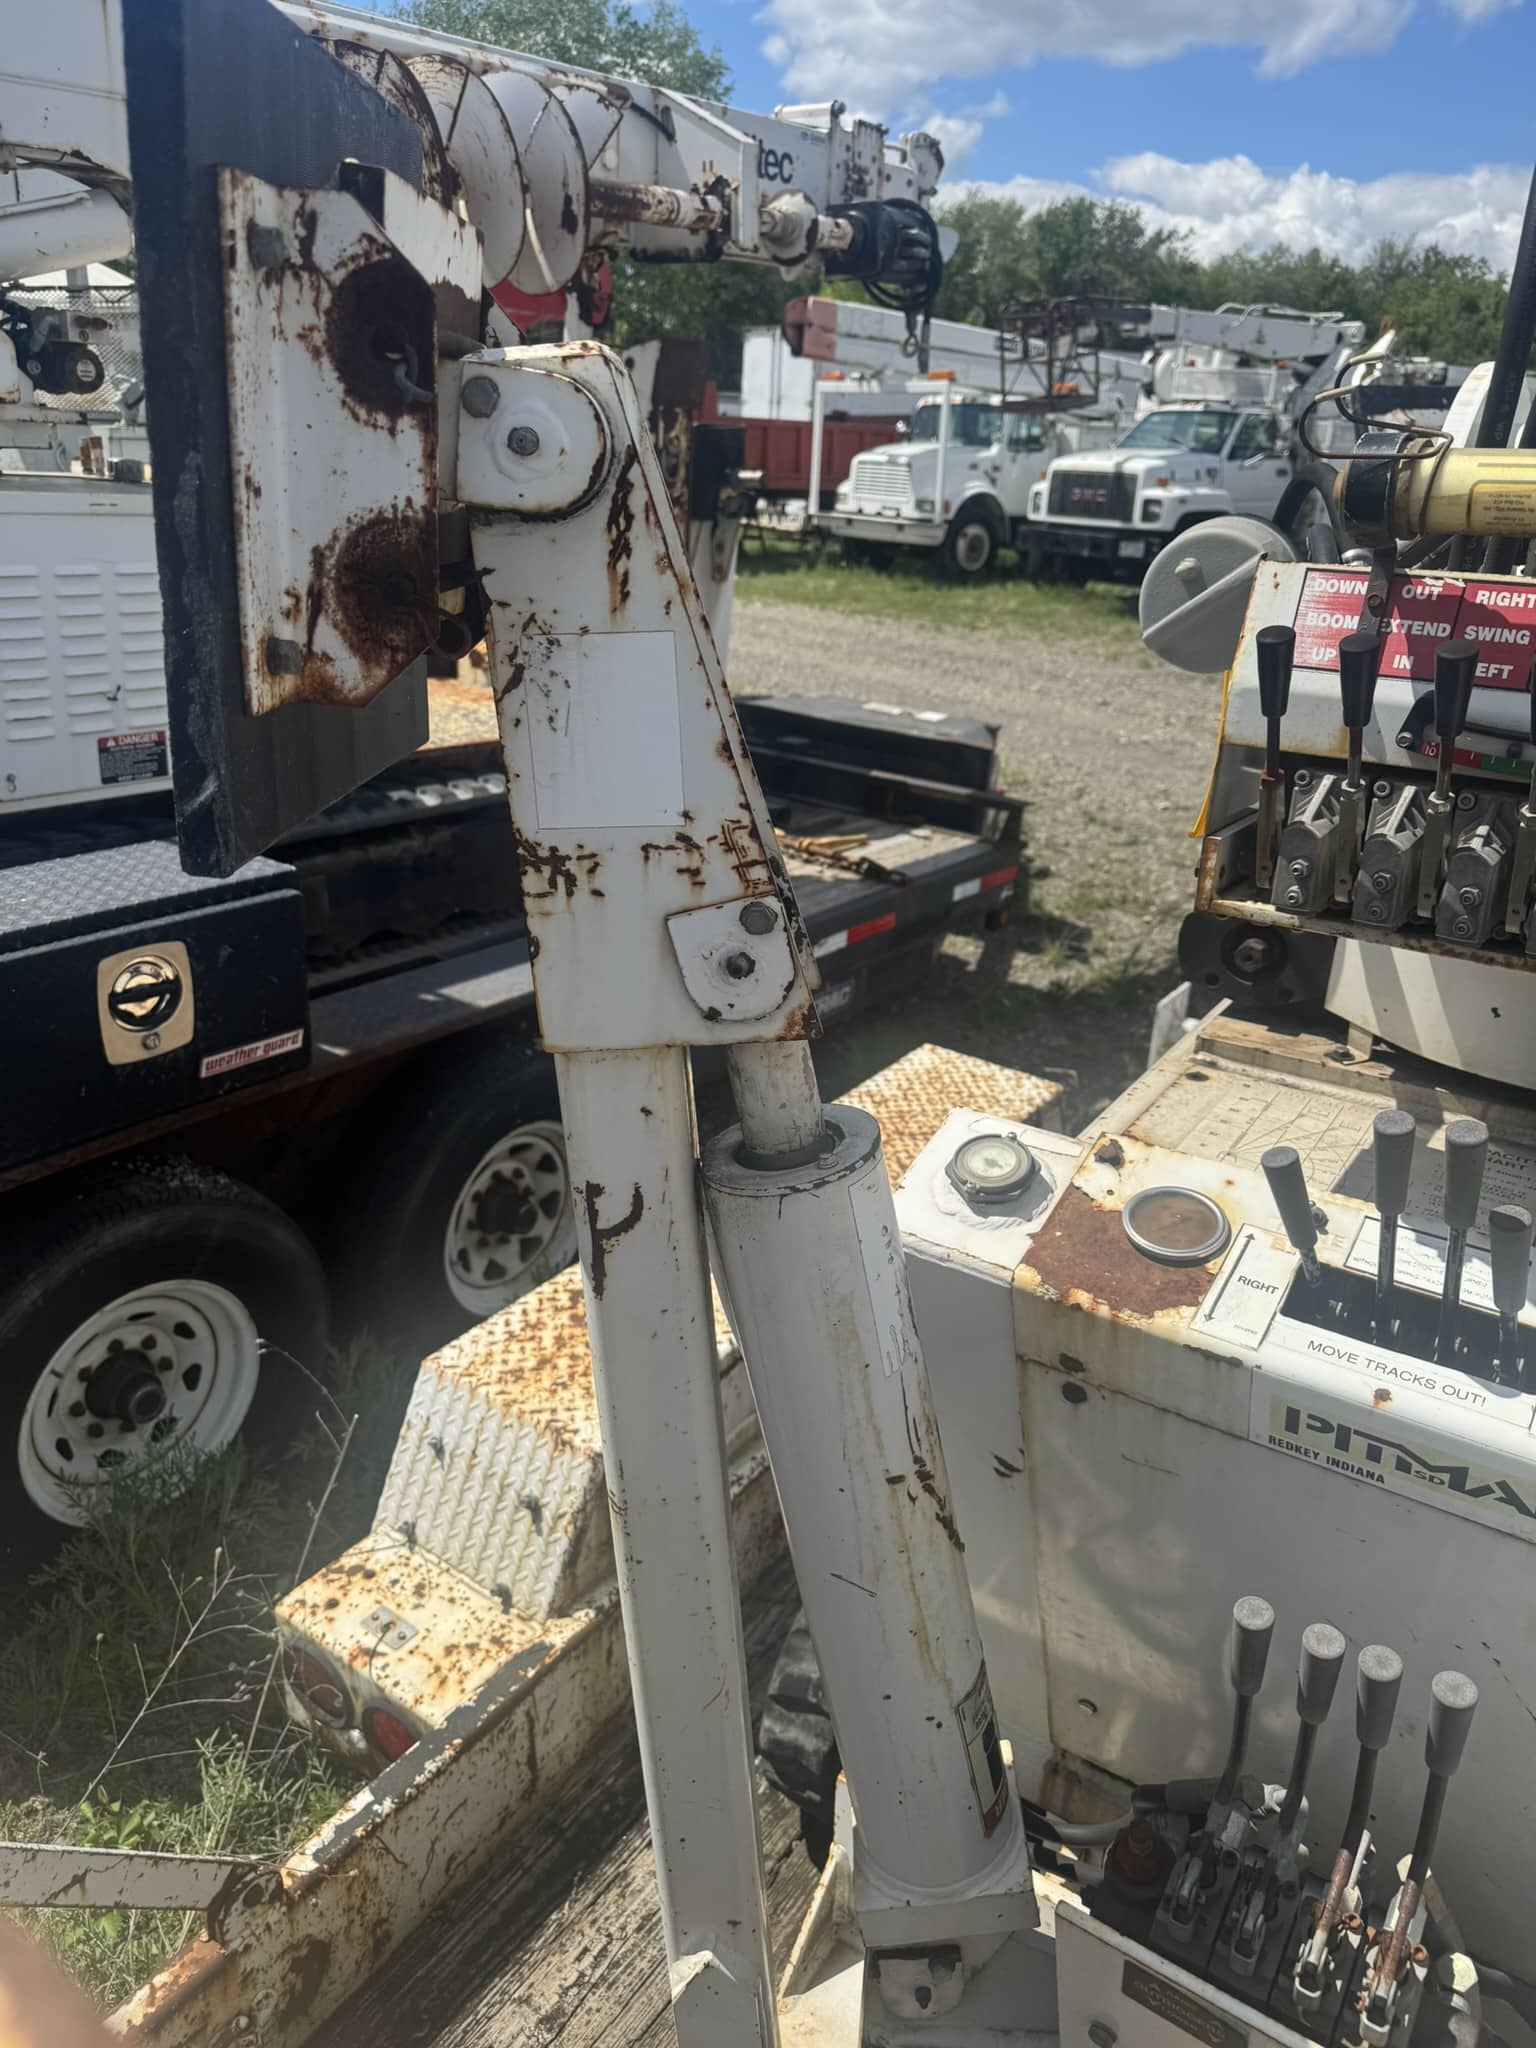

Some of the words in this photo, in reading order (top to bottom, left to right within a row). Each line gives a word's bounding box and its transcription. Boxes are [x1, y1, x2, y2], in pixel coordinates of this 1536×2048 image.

[745, 134, 794, 184] tec
[1313, 577, 1369, 595] DOWN
[1402, 584, 1443, 601] OUT
[1475, 589, 1536, 610] RIGHT
[1305, 611, 1360, 630] BOOM
[1463, 625, 1531, 646] SWING
[1311, 647, 1338, 662] UP
[1392, 654, 1414, 670] IN
[1474, 662, 1514, 680] EFT
[263, 1031, 301, 1058] guard
[1237, 1274, 1280, 1295] RIGHT
[1307, 1340, 1360, 1364] MOVE
[1365, 1357, 1436, 1389] TRACKS
[1441, 1384, 1487, 1407] OUT!
[1268, 1434, 1320, 1461] REDKEY
[1326, 1455, 1385, 1484] INDIANA
[1284, 1405, 1536, 1519] PITMA
